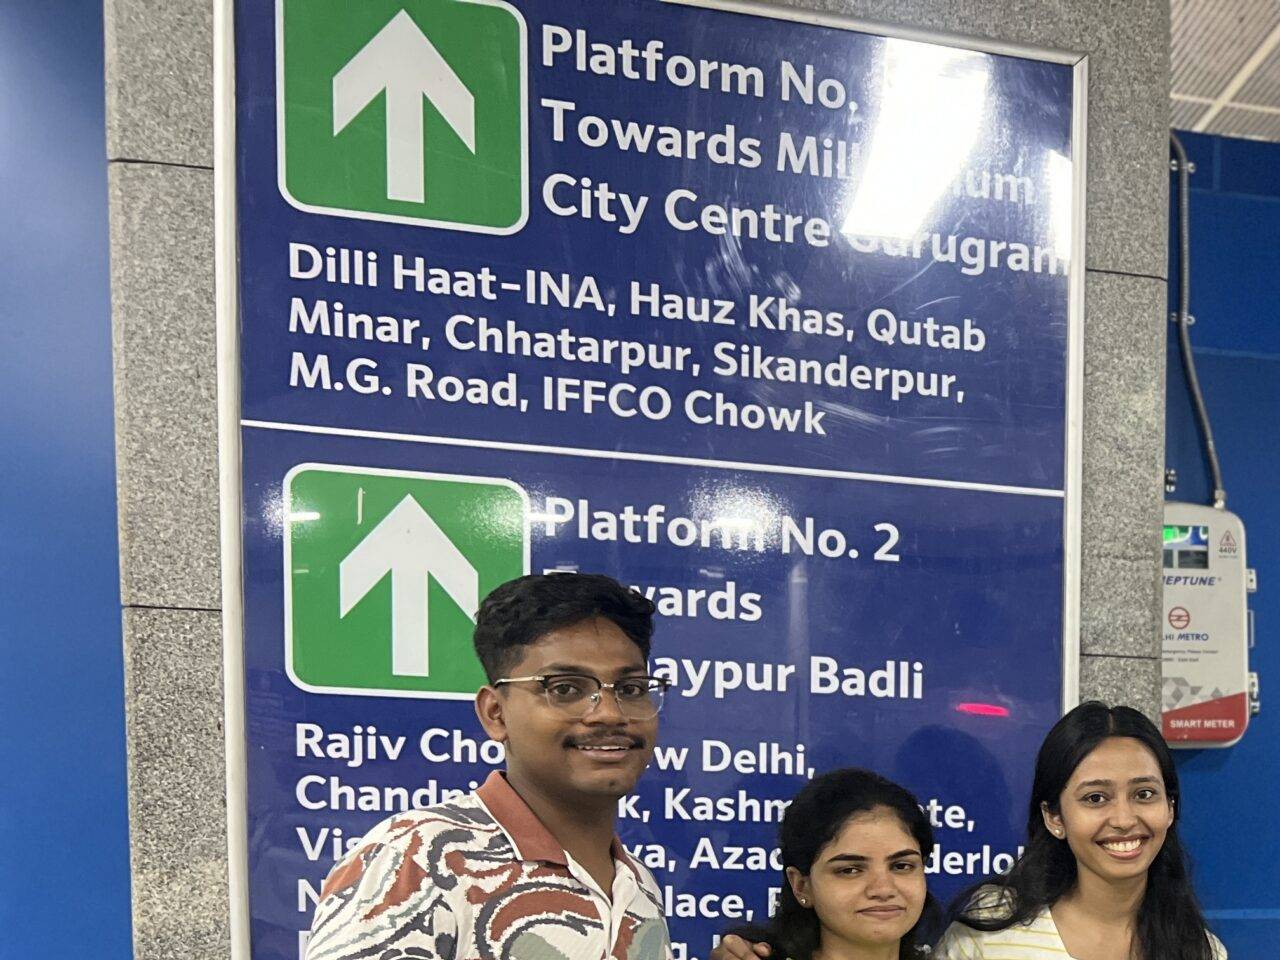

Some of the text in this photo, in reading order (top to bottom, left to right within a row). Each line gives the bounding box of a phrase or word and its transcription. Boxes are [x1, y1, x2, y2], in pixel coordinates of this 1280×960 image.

[543, 24, 764, 97] Platform
[541, 98, 762, 168] Towards
[542, 173, 649, 234] City
[664, 189, 831, 247] Centre
[289, 242, 986, 352] Dilli Haat-INA, Hauz Khas, Qutab
[289, 297, 964, 403] Minar, Chhatarpur, Sikanderpur,
[289, 351, 826, 435] M.G. Road, IFFCO Chowk
[545, 497, 900, 562] Platform No. 2
[1177, 633, 1209, 641] METRO
[810, 655, 923, 699] Badli
[295, 723, 406, 768] Rajiv
[420, 728, 506, 764] Cho
[702, 739, 815, 779] Delhi,
[1170, 720, 1235, 728] SMART METER
[665, 885, 754, 922] lace,
